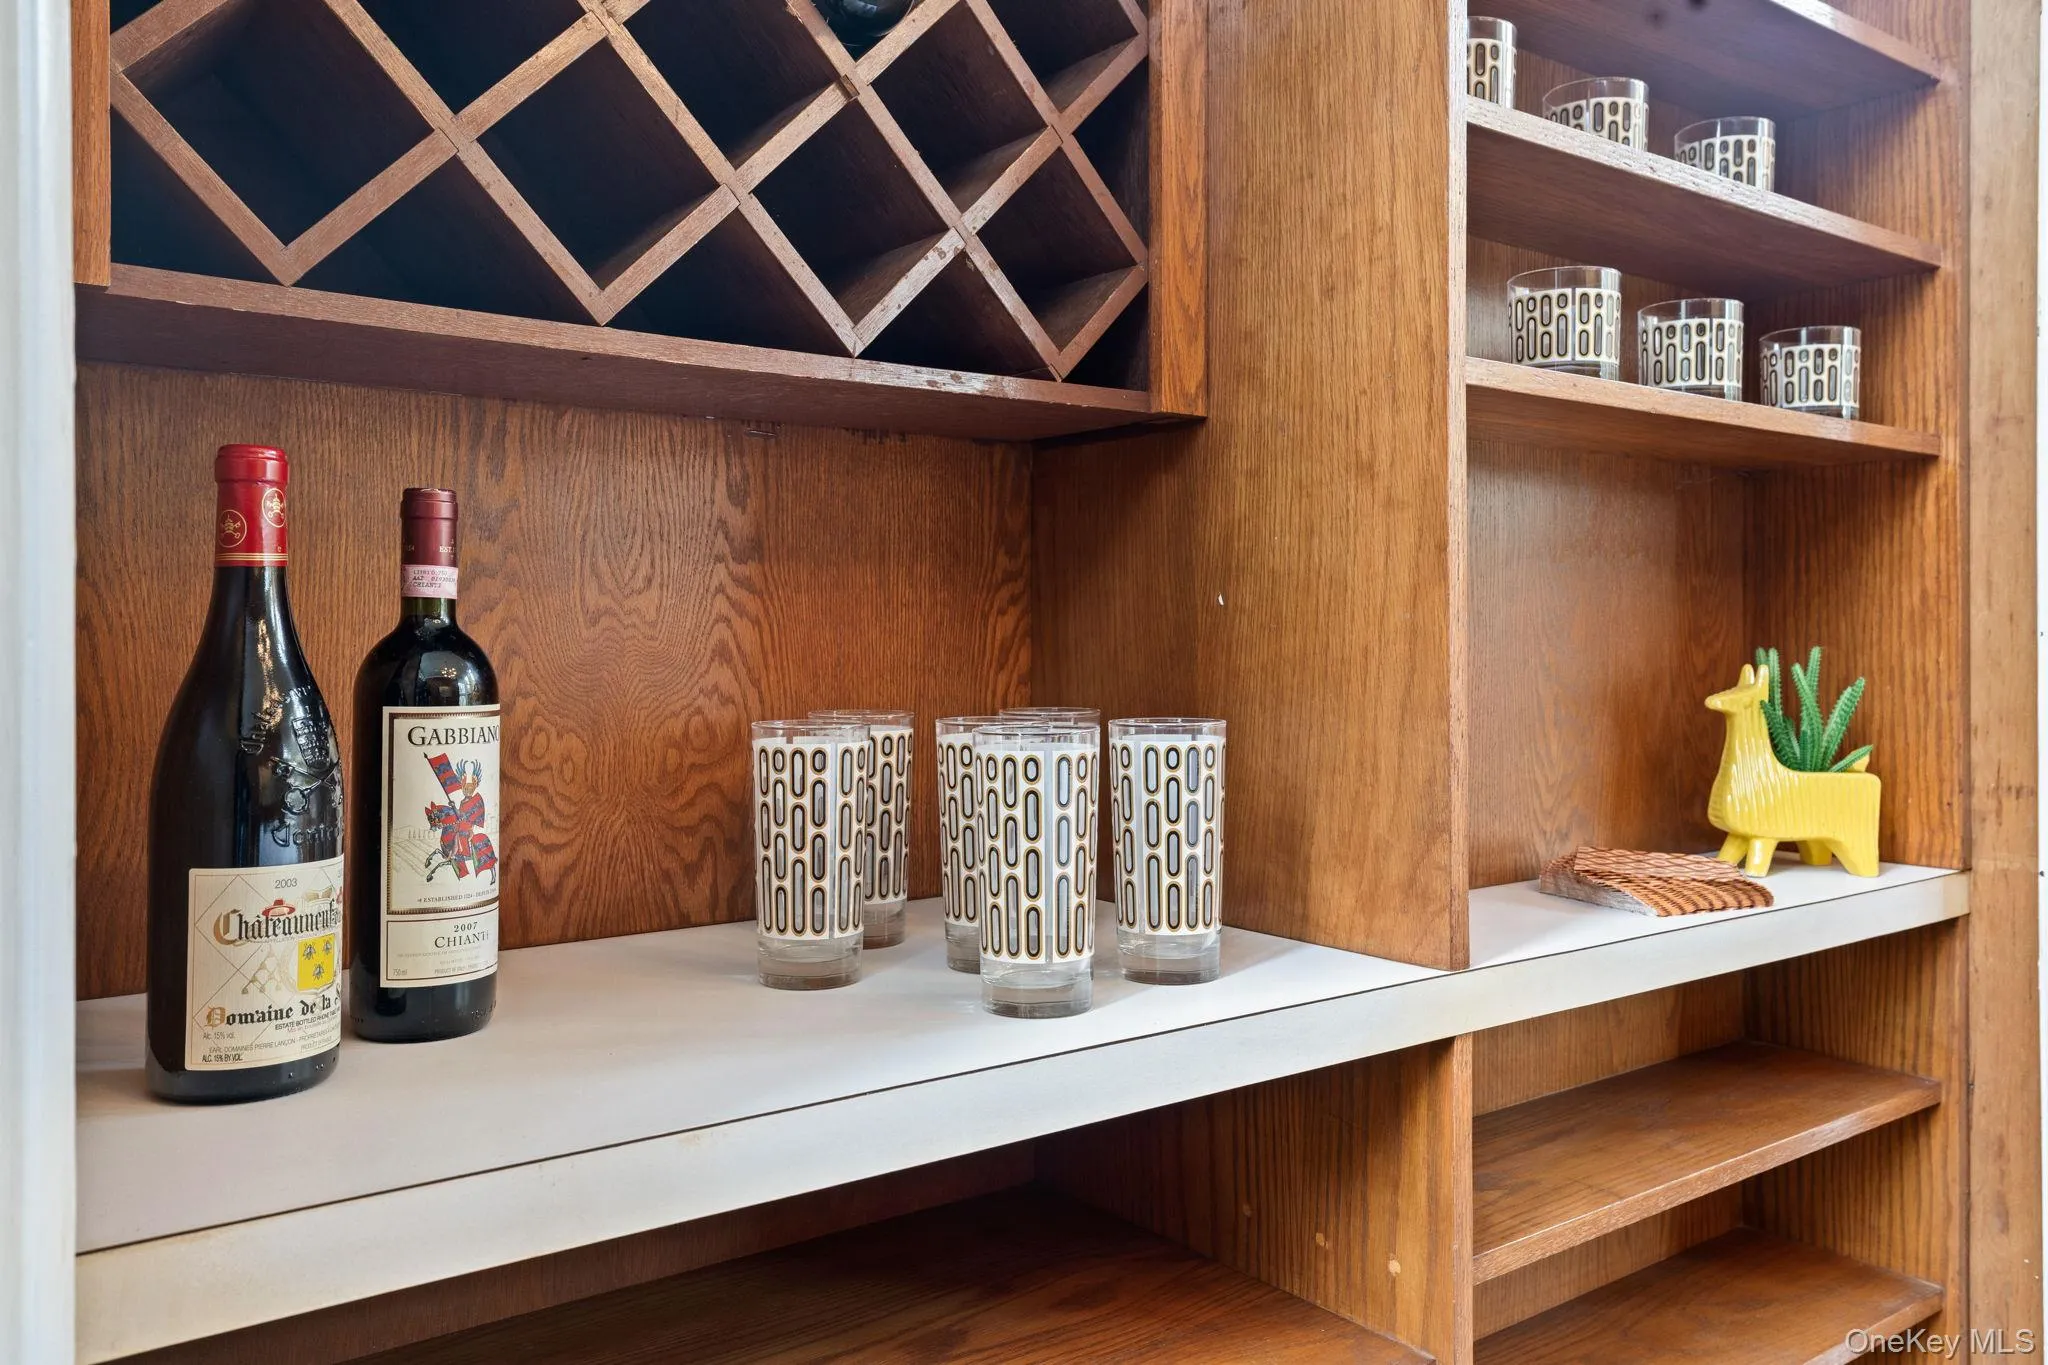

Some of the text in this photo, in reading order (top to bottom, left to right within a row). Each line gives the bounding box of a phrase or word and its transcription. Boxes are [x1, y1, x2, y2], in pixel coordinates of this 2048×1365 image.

[407, 725, 499, 746] GABBIANO
[275, 878, 298, 889] 2003
[423, 894, 463, 903] ESTABLISHED
[453, 921, 478, 932] 2007
[434, 930, 489, 949] CHIANTI
[204, 1003, 294, 1030] Domaine
[300, 1000, 317, 1016] de
[322, 994, 331, 1010] la
[275, 1021, 295, 1031] ESTATE
[295, 1016, 317, 1027] BOTTLED
[213, 1032, 226, 1040] 15%
[223, 1044, 254, 1053] DOMAINES
[254, 1041, 274, 1051] PIERRE
[201, 1054, 212, 1063] ALC.
[213, 1054, 224, 1062] 15%
[224, 1053, 231, 1062] BY
